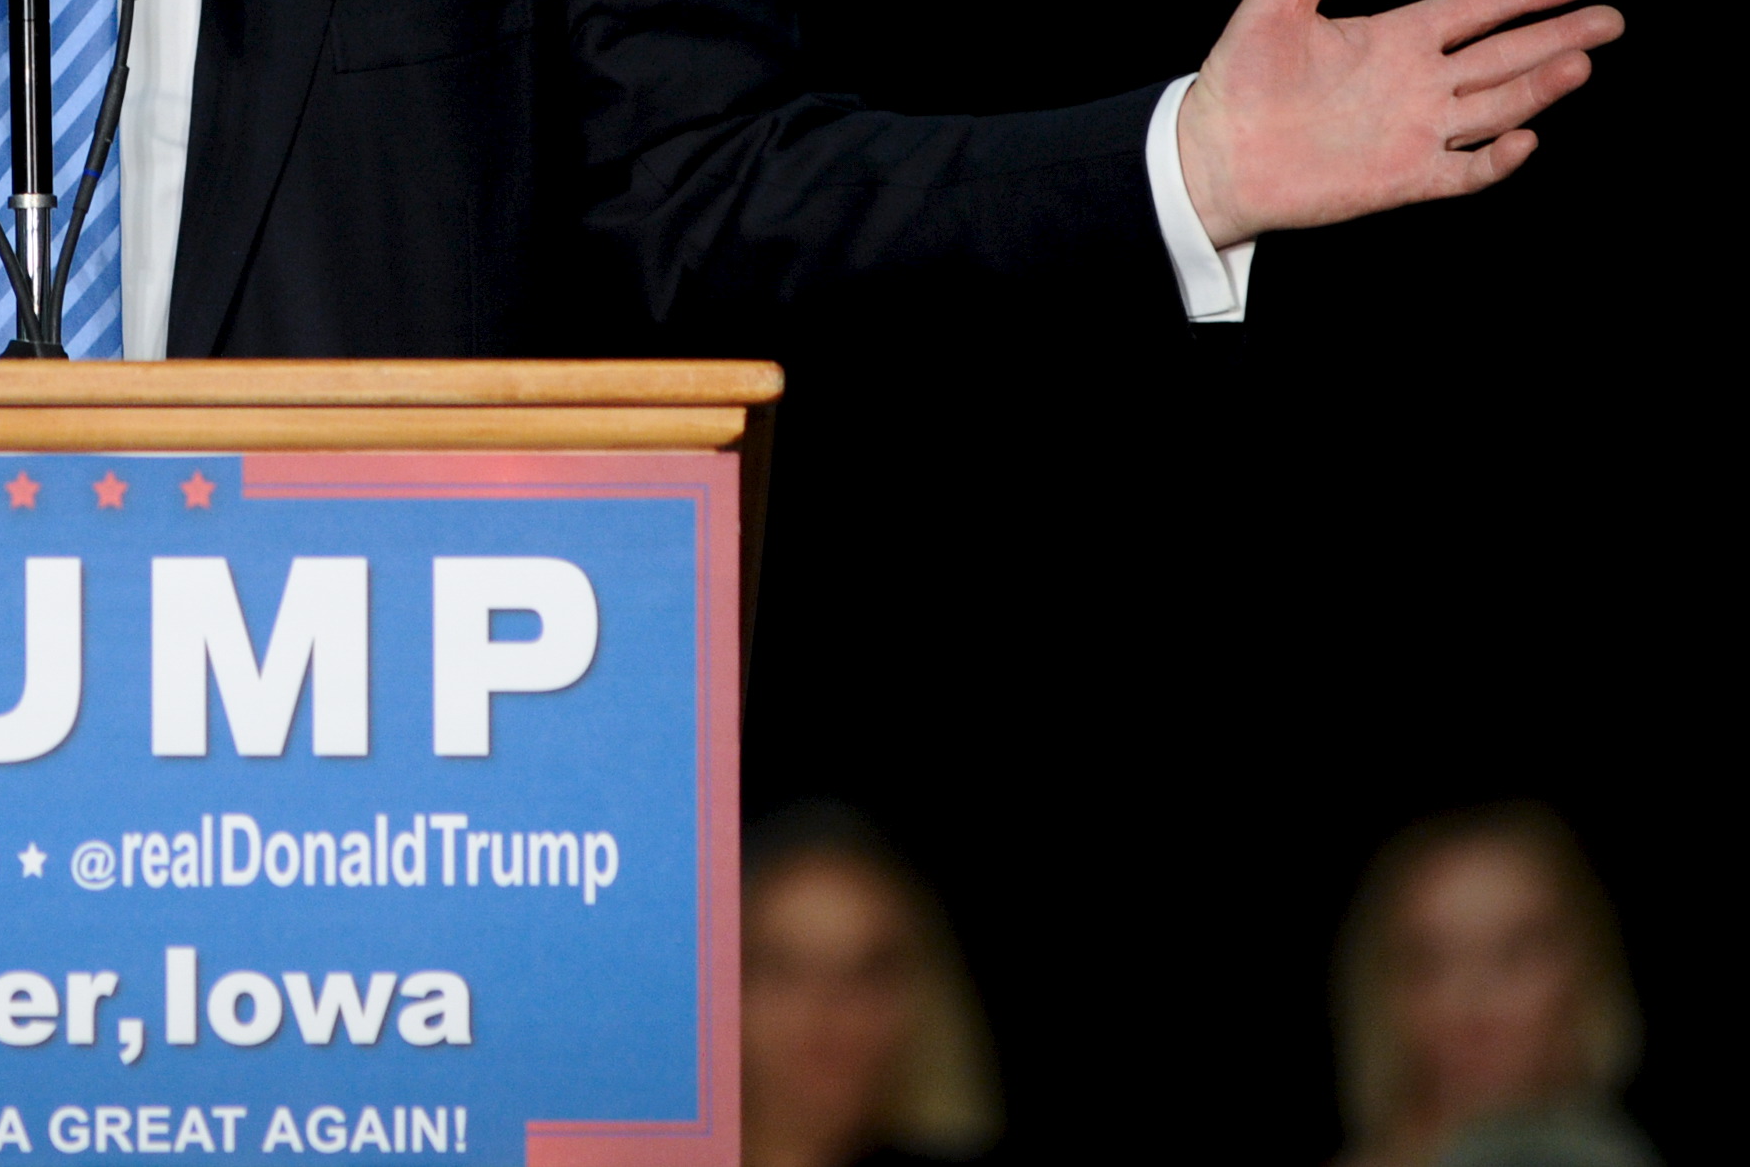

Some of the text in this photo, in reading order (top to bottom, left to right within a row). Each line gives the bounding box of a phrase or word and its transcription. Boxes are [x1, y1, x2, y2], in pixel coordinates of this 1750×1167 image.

[69, 811, 620, 906] @realDonaldTrump
[47, 1104, 248, 1154] GREAT
[261, 1104, 468, 1154] AGAIN!
